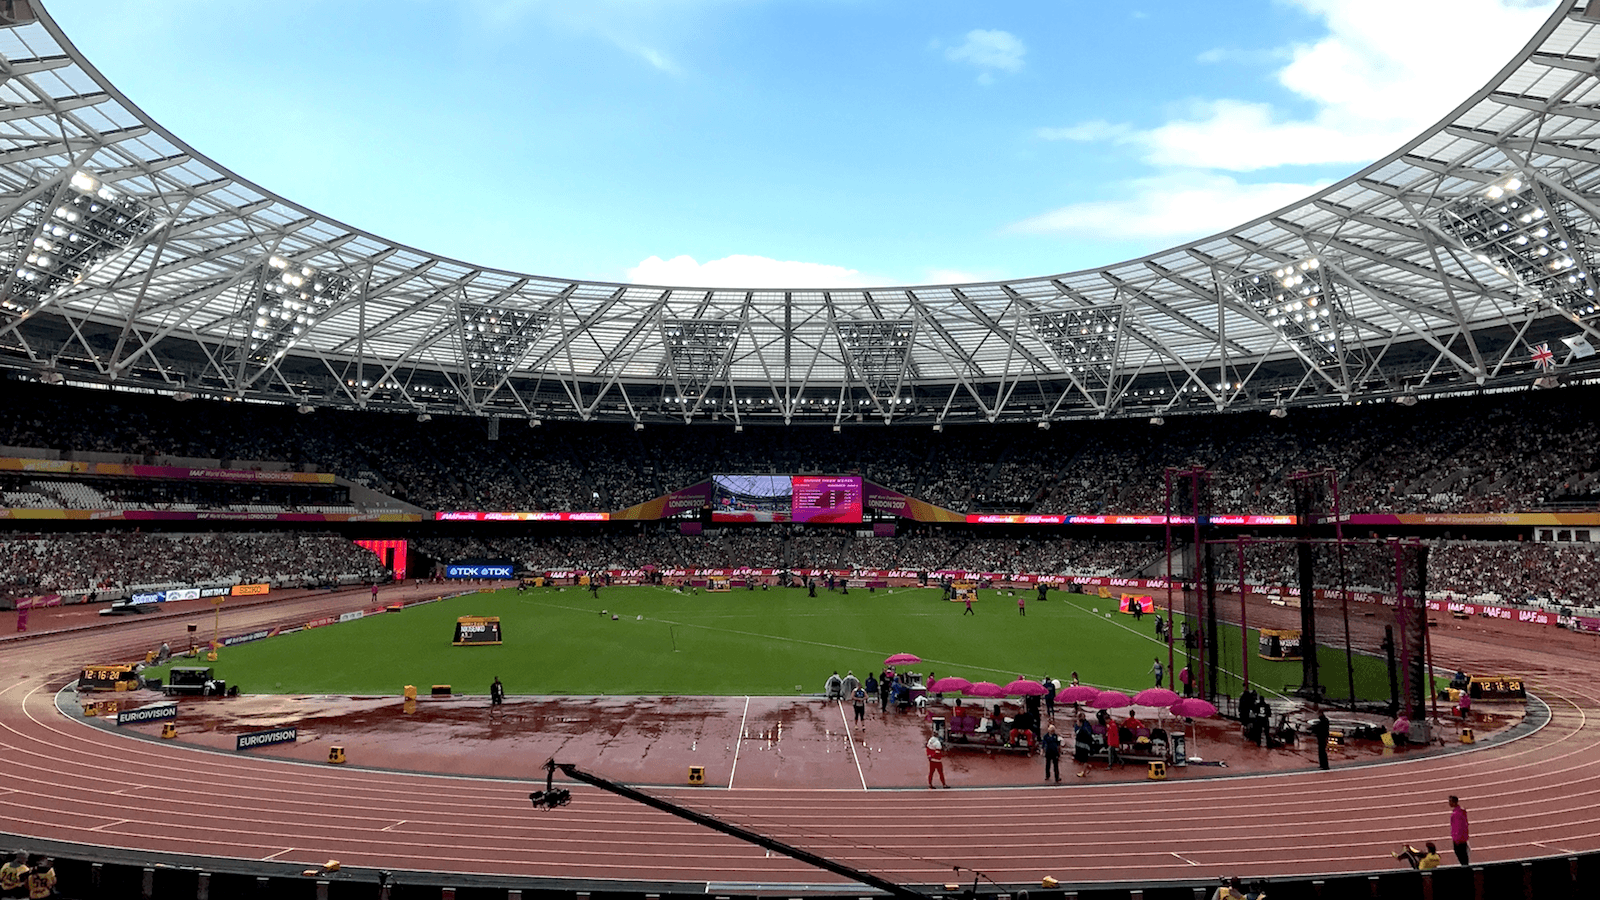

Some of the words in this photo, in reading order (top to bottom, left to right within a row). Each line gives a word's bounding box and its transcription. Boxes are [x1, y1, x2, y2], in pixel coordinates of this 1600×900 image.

[669, 499, 692, 508] LONDON
[869, 499, 892, 509] LONDON
[893, 501, 905, 509] 2017
[459, 567, 478, 576] TDK
[490, 567, 510, 576] TDK
[239, 586, 261, 595] SEIKO
[1483, 605, 1511, 619] IAAF.ORG
[1519, 610, 1548, 623] IAAF.ORG
